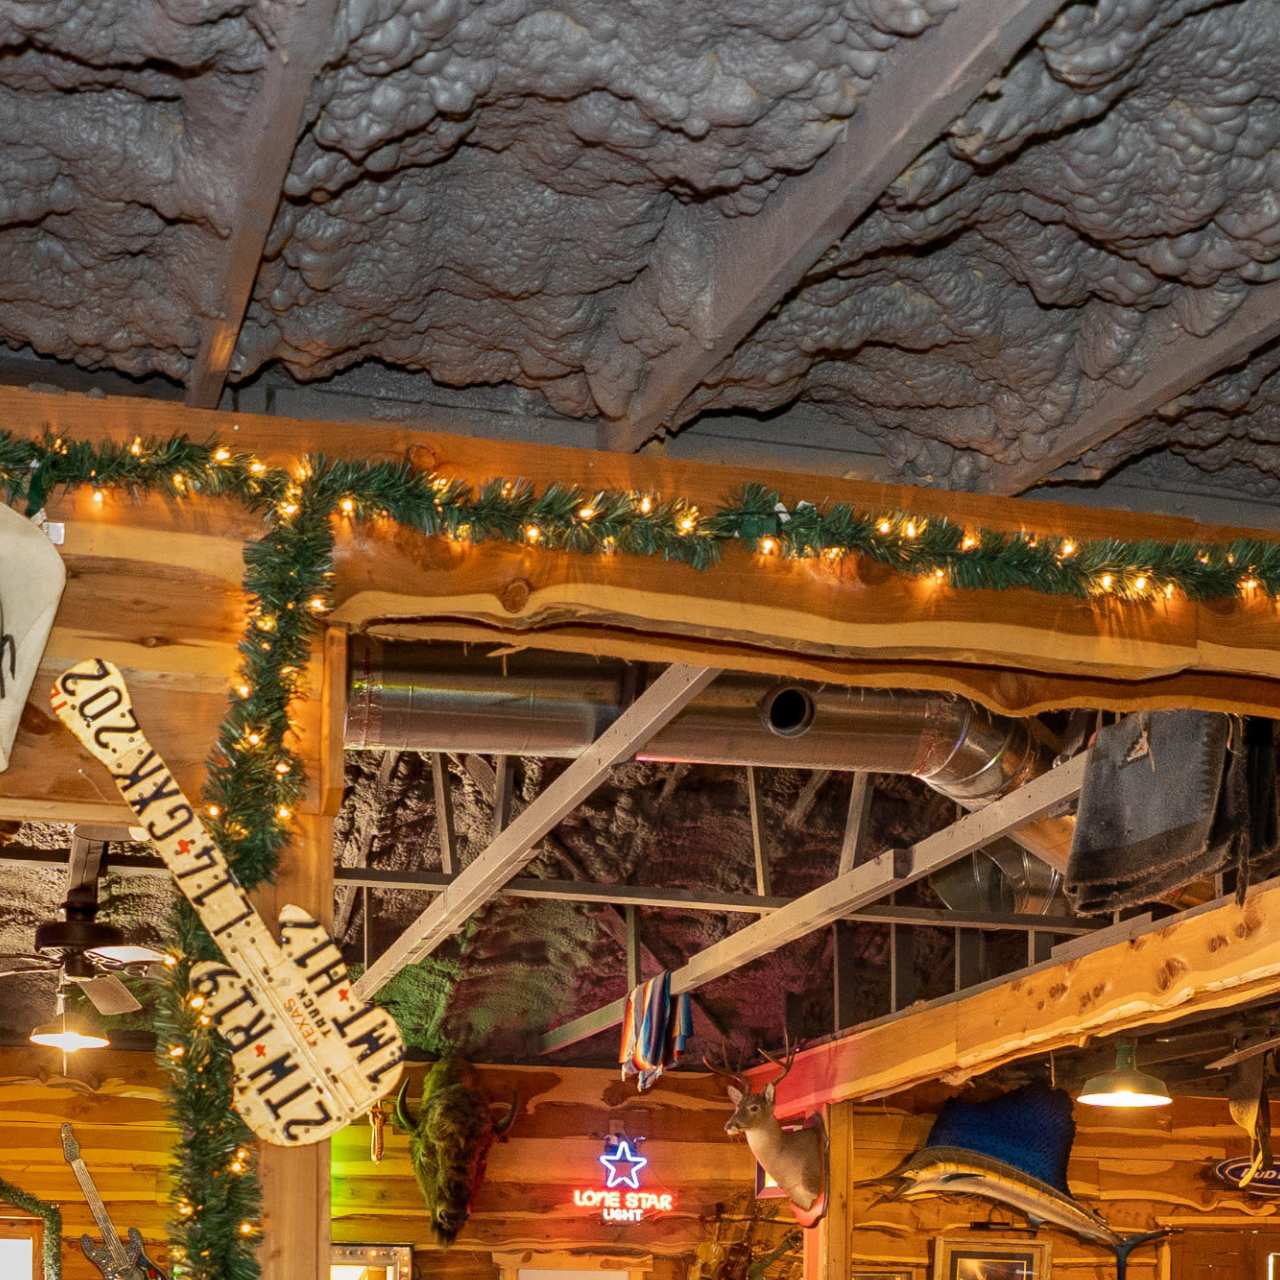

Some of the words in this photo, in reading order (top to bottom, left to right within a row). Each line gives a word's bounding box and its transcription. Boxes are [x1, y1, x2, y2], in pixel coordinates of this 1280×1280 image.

[59, 658, 140, 751] 202
[113, 749, 195, 843] GXK
[173, 843, 256, 939] L14
[190, 966, 275, 1056] R19
[285, 996, 319, 1048] TEXAS
[296, 990, 332, 1037] TRUCK
[246, 1052, 331, 1142] 2TW
[573, 1189, 620, 1207] LONE
[625, 1191, 673, 1210] STAR
